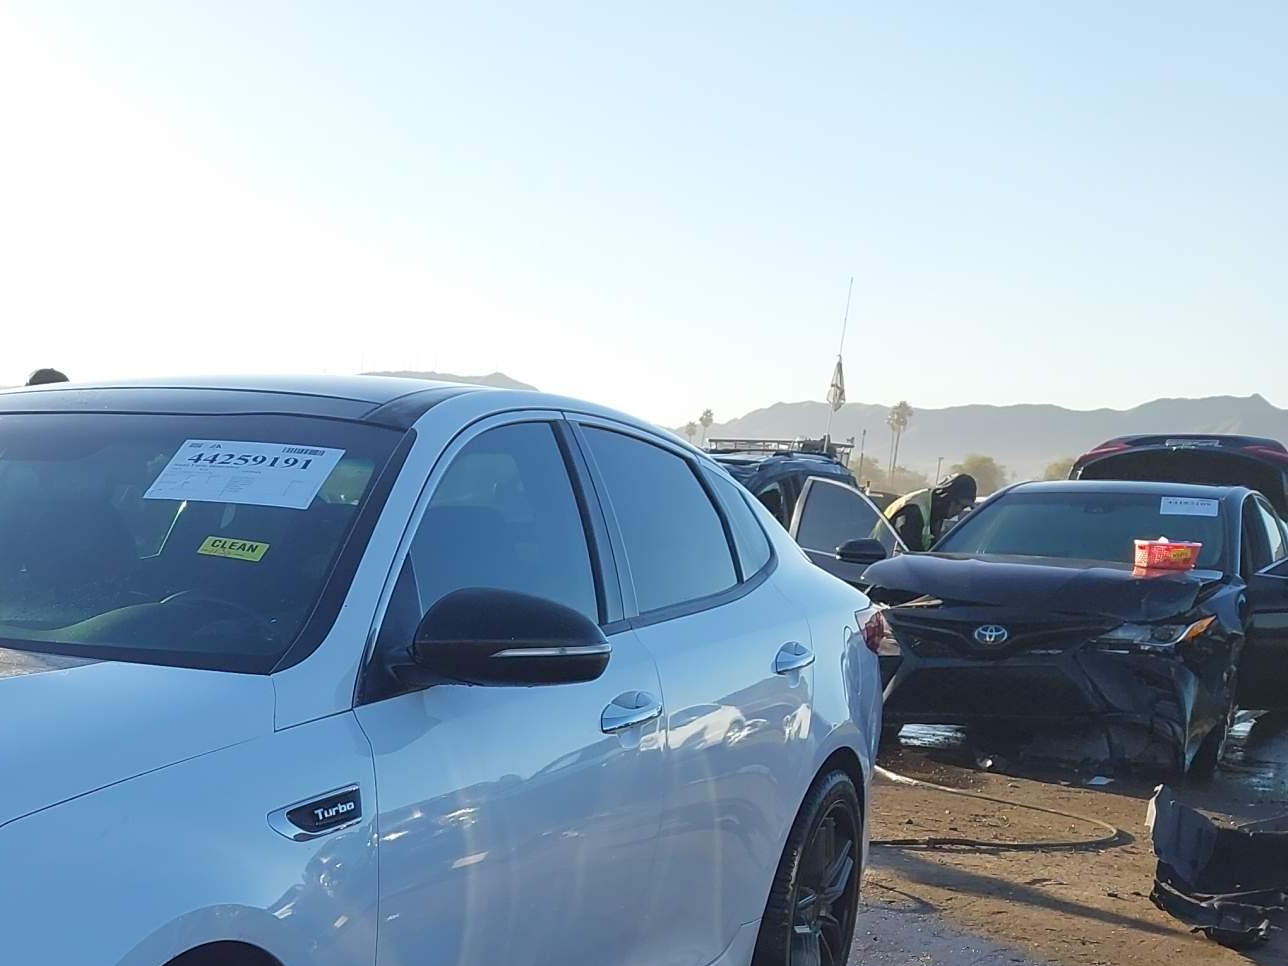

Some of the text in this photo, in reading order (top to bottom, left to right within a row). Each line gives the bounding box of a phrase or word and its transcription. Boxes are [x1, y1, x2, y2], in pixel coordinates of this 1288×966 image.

[187, 452, 312, 470] 44259191
[211, 539, 259, 553] CLEAN
[314, 801, 355, 821] Turbo
